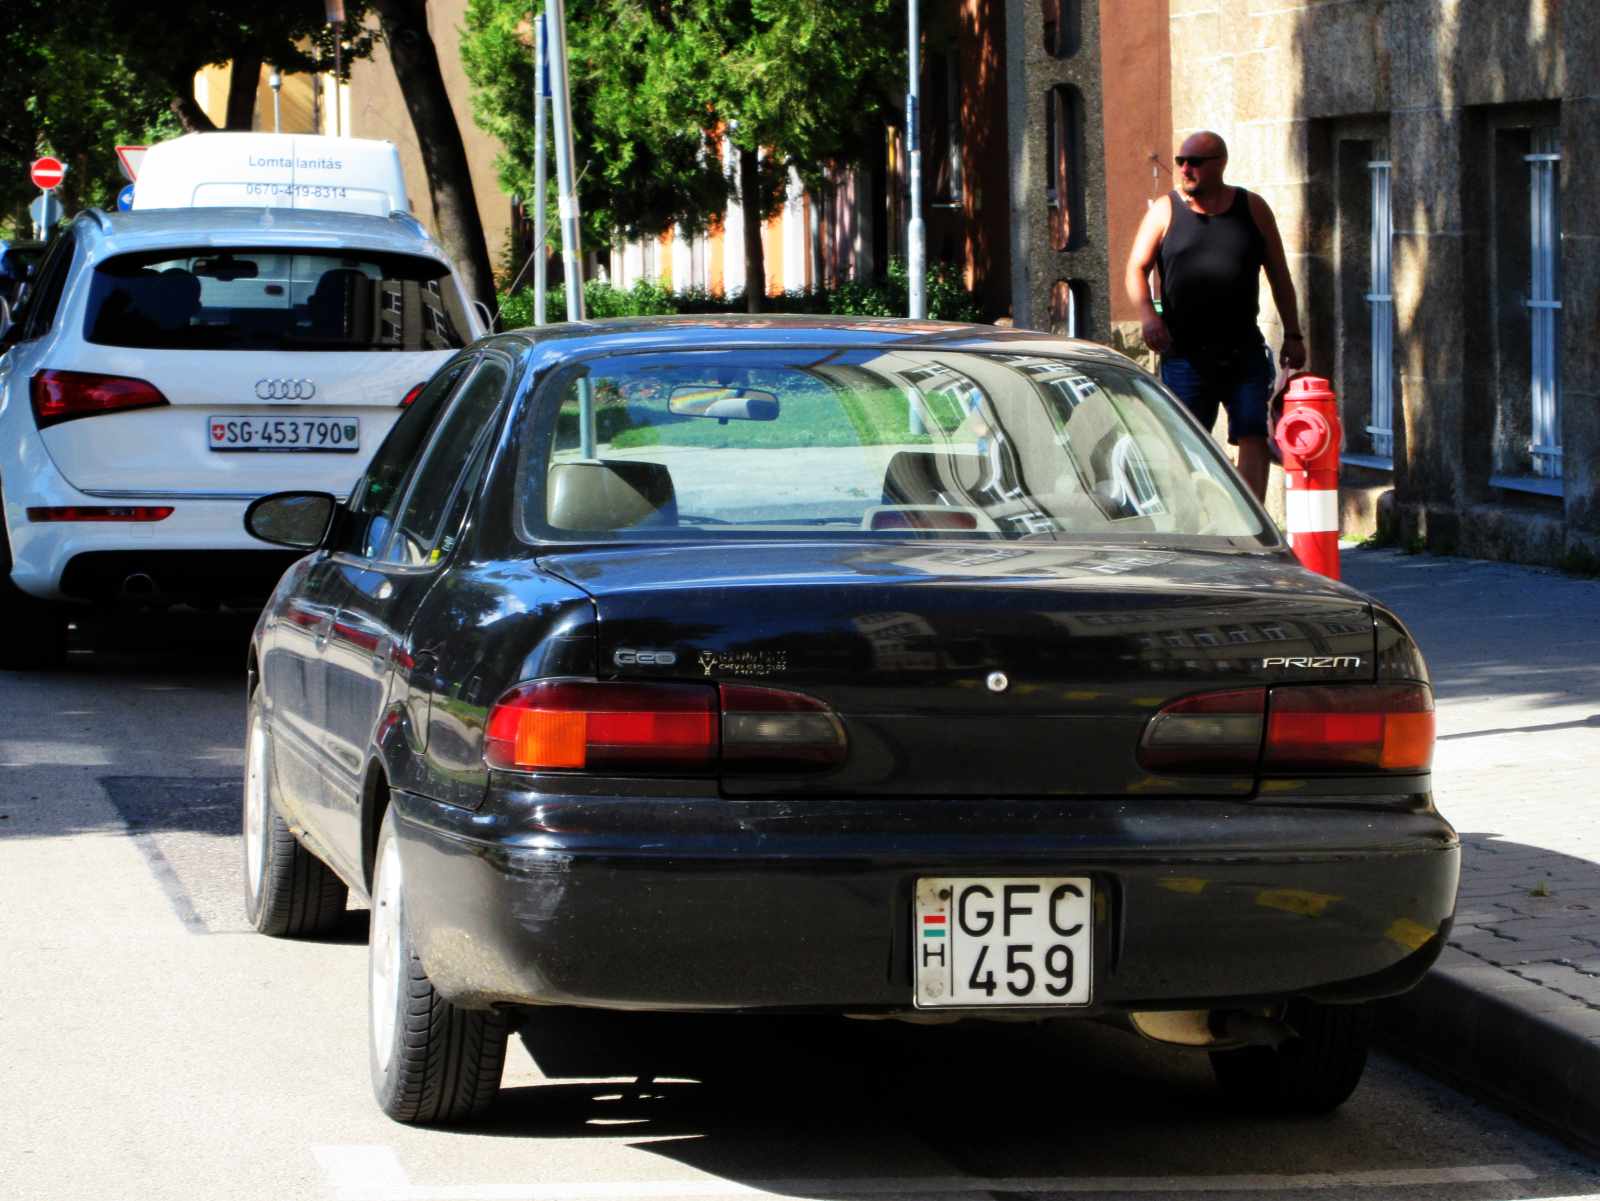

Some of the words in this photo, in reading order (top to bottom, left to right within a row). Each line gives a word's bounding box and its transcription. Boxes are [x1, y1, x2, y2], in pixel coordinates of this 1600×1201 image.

[958, 884, 1084, 937] GFC
[923, 943, 945, 967] H
[968, 944, 1074, 997] 459
